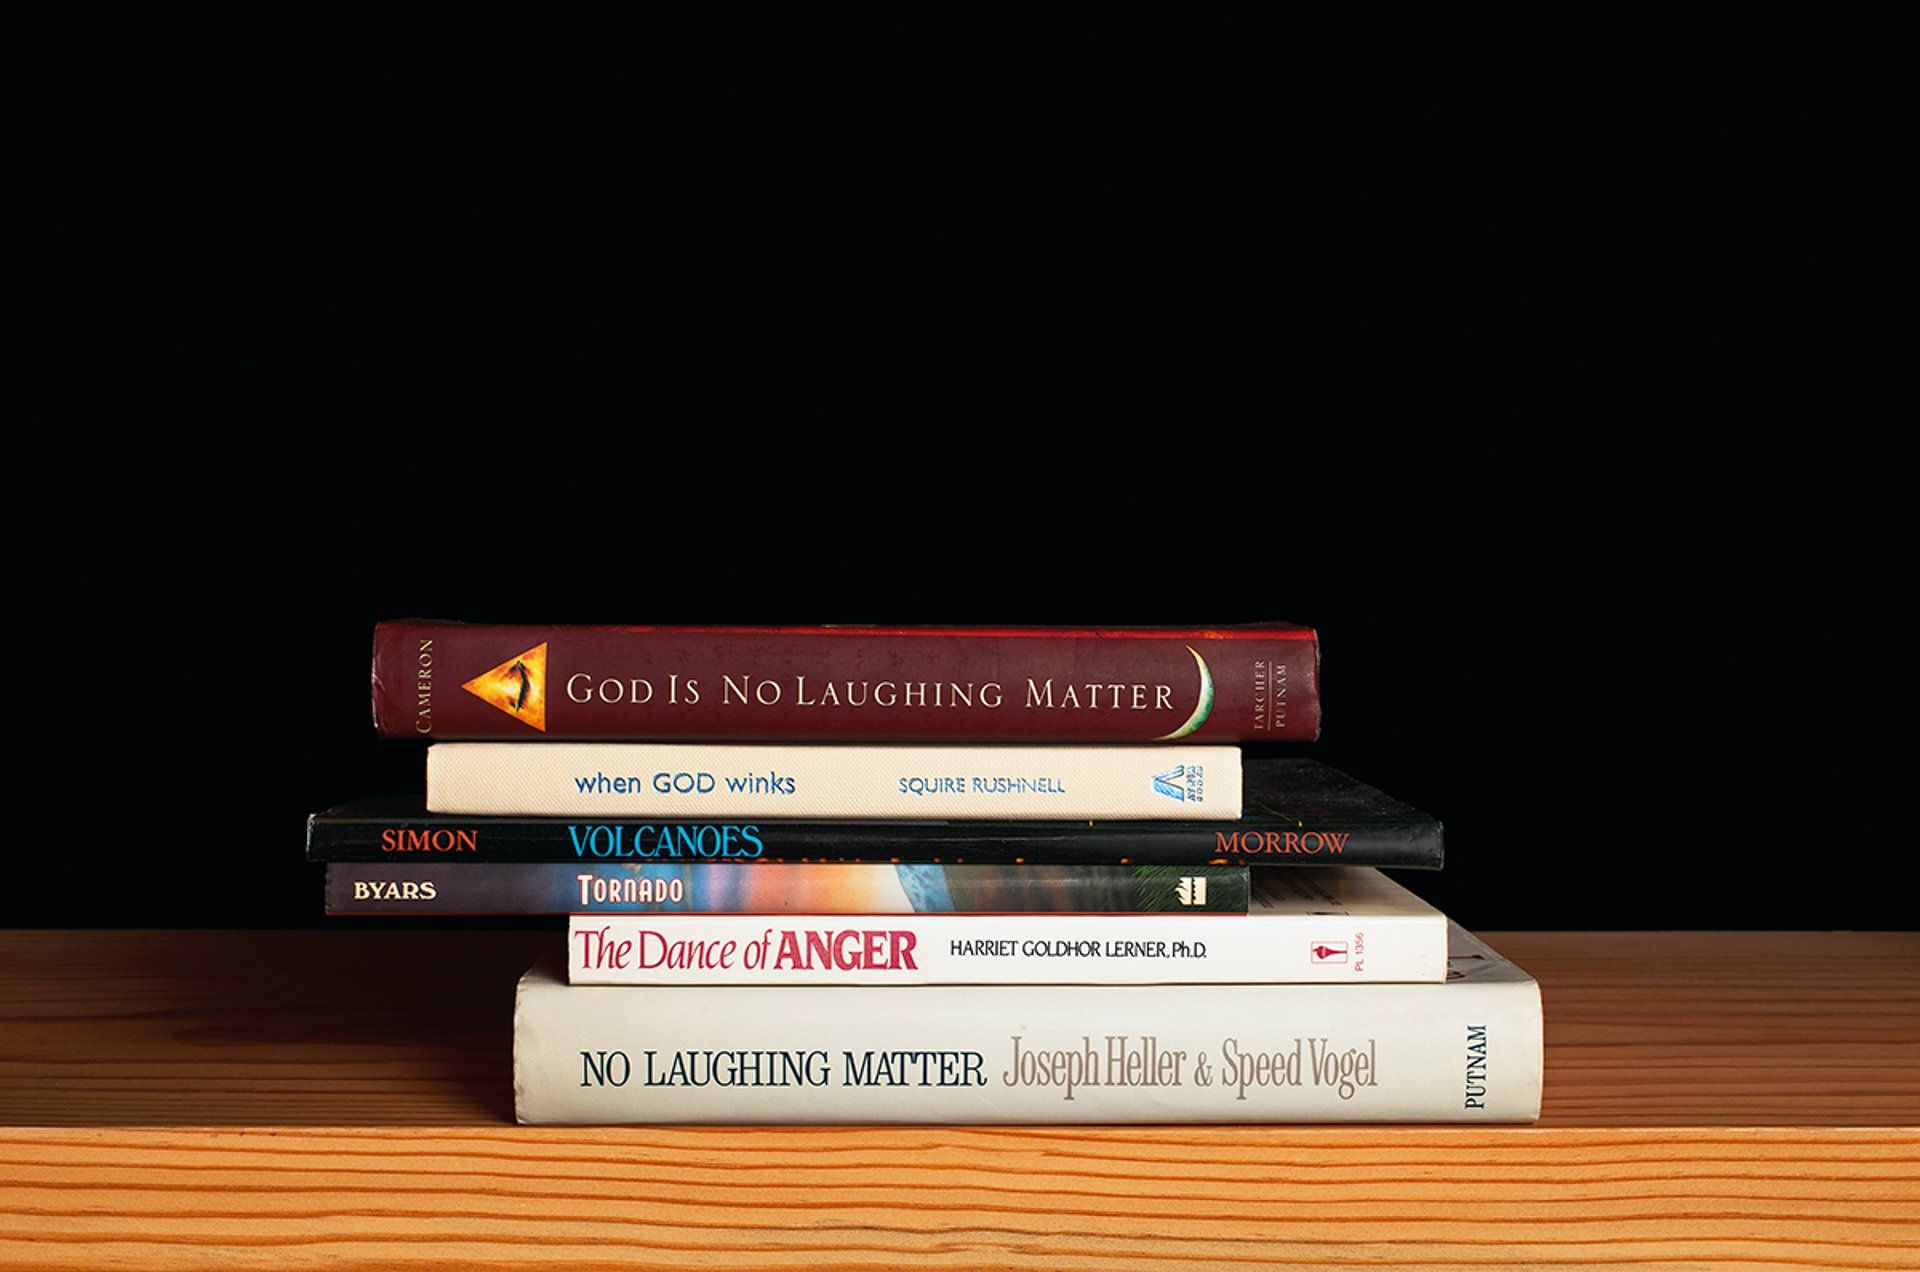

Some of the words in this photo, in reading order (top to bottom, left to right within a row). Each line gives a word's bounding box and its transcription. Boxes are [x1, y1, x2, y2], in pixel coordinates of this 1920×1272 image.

[416, 639, 433, 734] CAMERON
[796, 676, 1003, 707] LAUGHING
[1025, 678, 1173, 709] MATTER
[1254, 661, 1265, 729] TARCHER
[1275, 664, 1287, 727] PUTNAM
[574, 771, 641, 794] when
[652, 772, 716, 794] GOD
[724, 770, 796, 795] winks
[898, 777, 966, 796] SQUIRE
[972, 777, 1066, 794] RUSHNELL
[381, 829, 478, 851] SIMON
[568, 825, 763, 857] VOLCANOES
[1215, 831, 1349, 854] MORROW
[354, 881, 437, 900] BYARS
[577, 874, 684, 904] TORNADO
[574, 925, 633, 970] The
[638, 930, 737, 970] Dance
[743, 928, 774, 970] of
[776, 929, 919, 971] ANGER
[950, 939, 1019, 957] HARRIET
[1021, 940, 1102, 958] GOLDHOR
[1105, 941, 1170, 959] LERNER,
[1171, 940, 1207, 958] Ph.D.
[1354, 959, 1364, 972] PL
[579, 1050, 631, 1087] NO
[643, 1050, 831, 1087] LAUGHING
[842, 1050, 988, 1087] MATTER
[1002, 1036, 1101, 1101] Joseph
[1103, 1036, 1187, 1087] Heller
[1194, 1051, 1213, 1087] &
[1221, 1037, 1303, 1101] Speed
[1307, 1038, 1378, 1101] Vogel
[1464, 1025, 1487, 1110] PUTNAM
